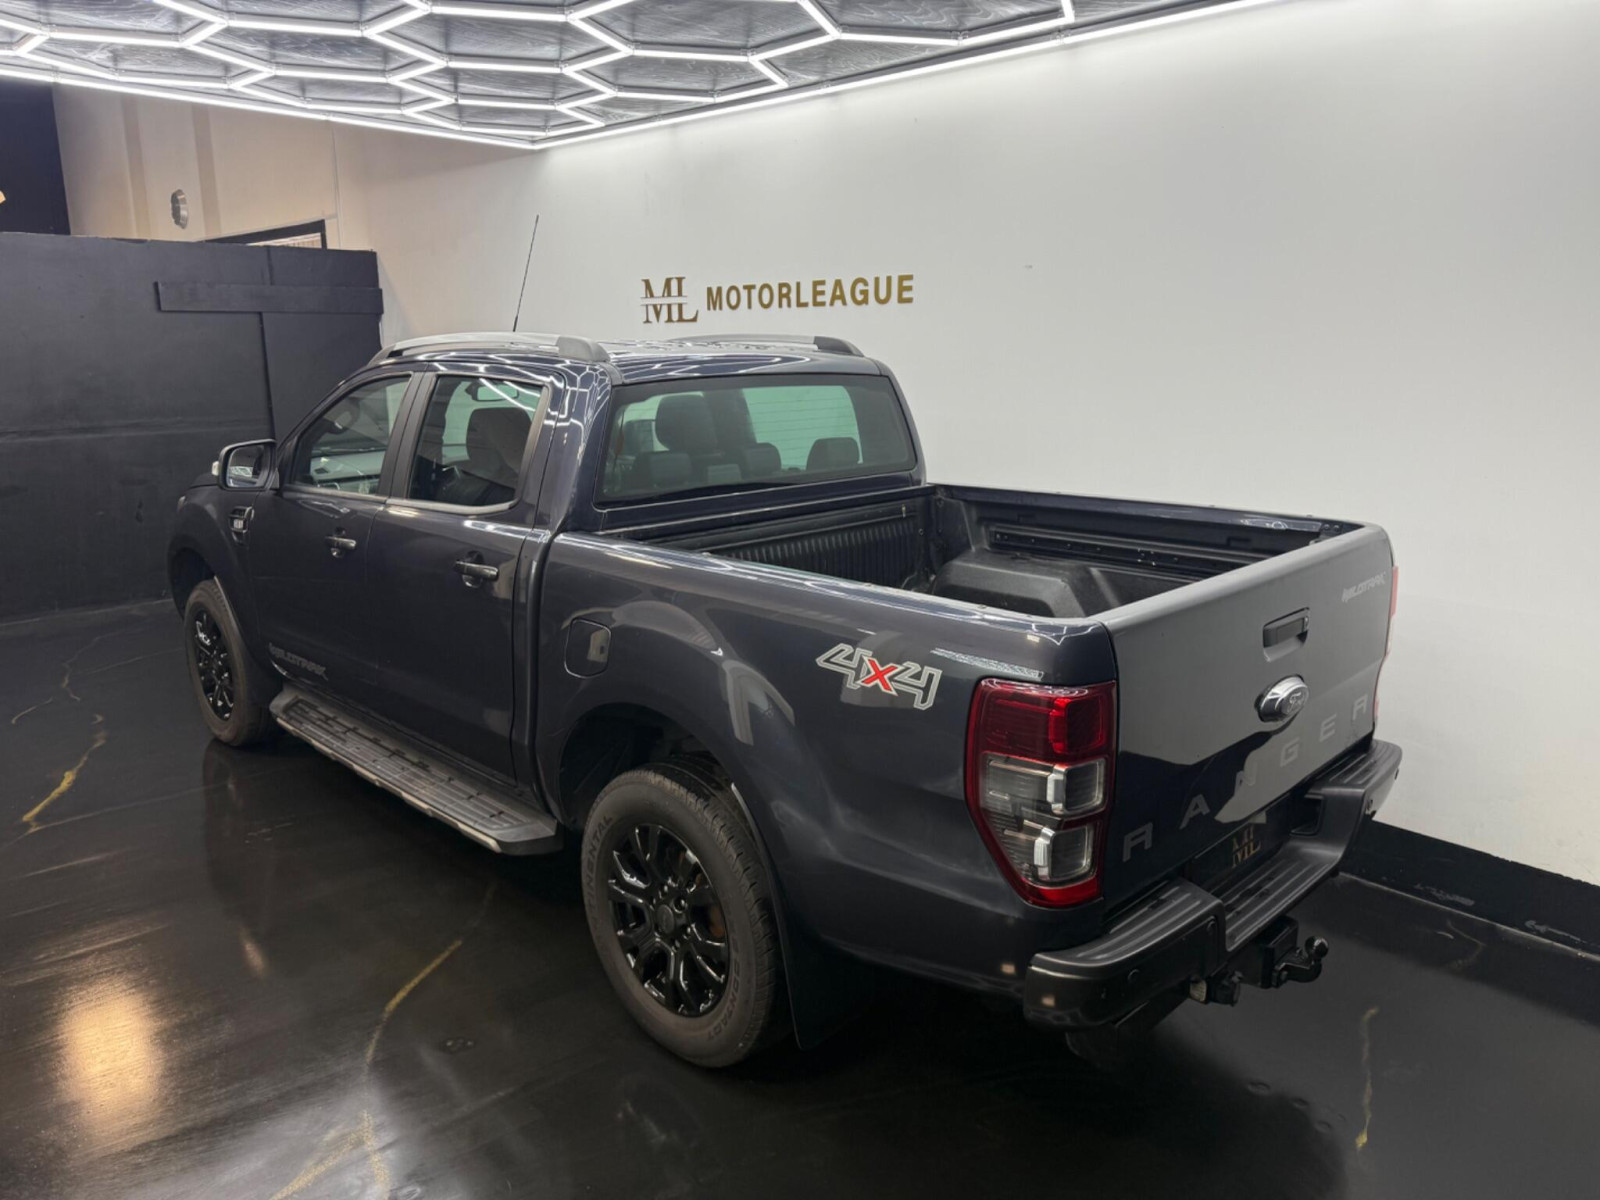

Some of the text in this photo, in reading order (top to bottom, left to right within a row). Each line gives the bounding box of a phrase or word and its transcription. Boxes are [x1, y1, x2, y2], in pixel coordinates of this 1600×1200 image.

[640, 274, 914, 324] ML MOTORLEAGUE
[1231, 824, 1262, 868] ML
